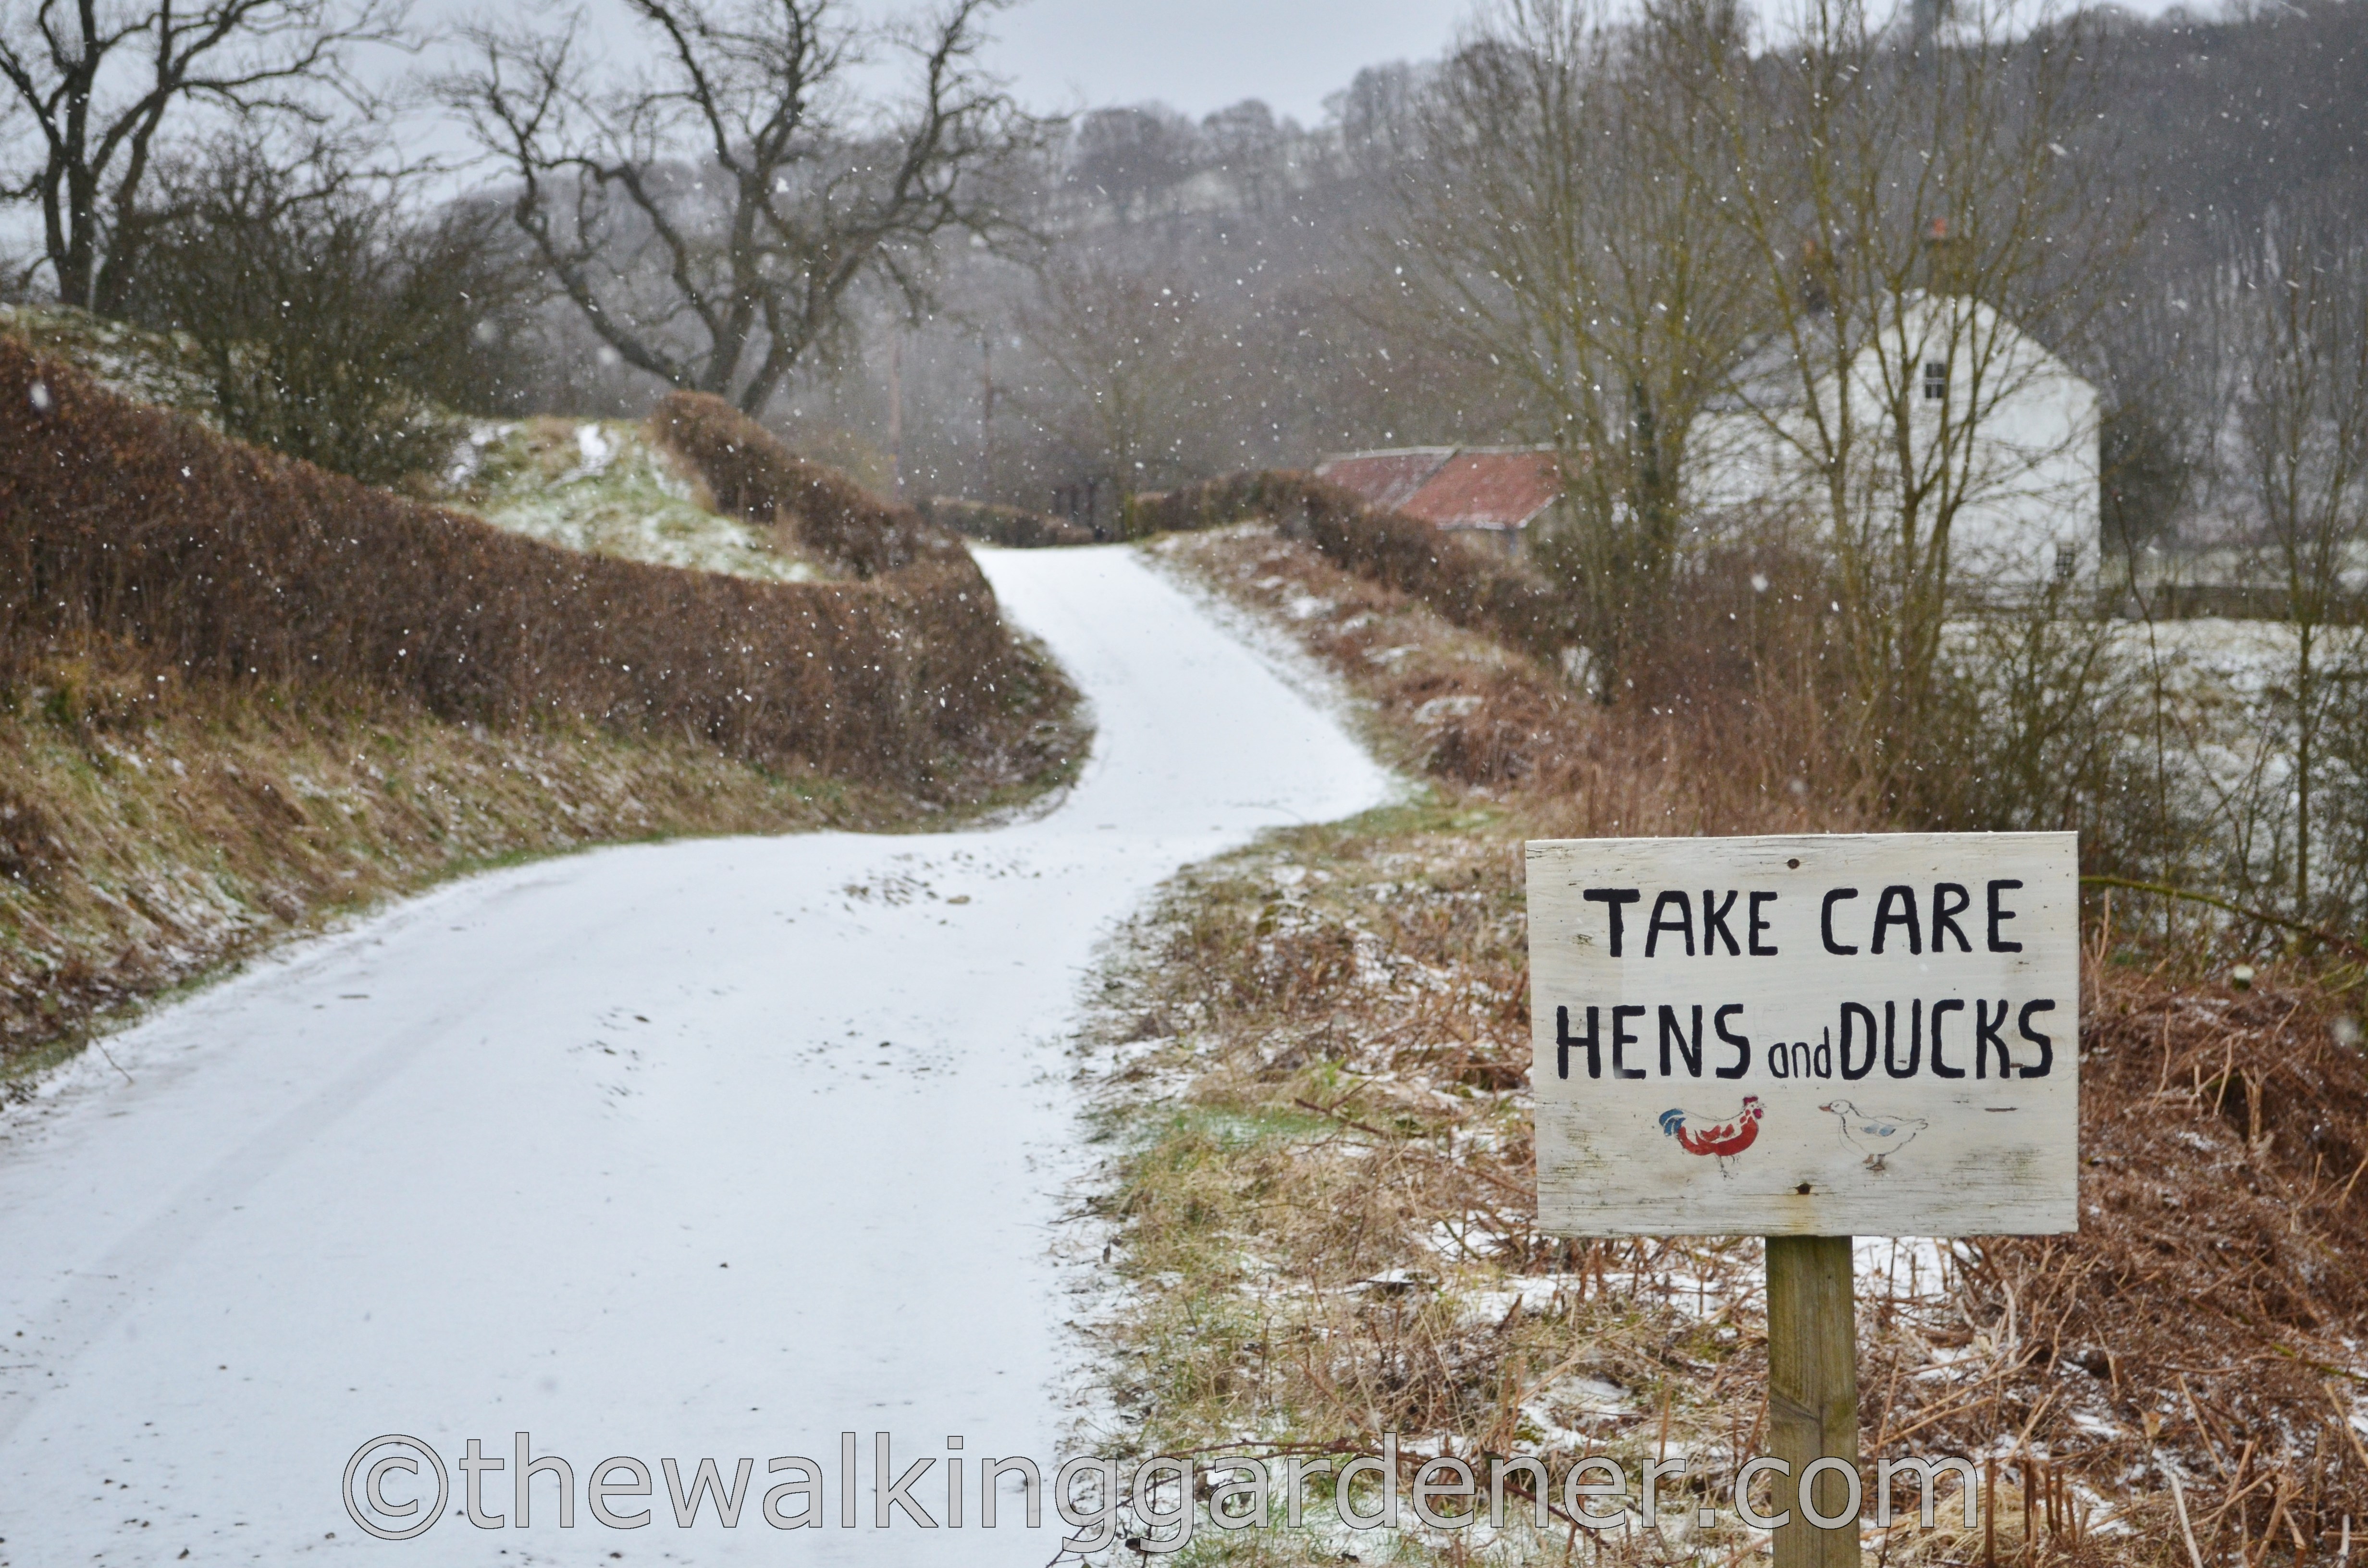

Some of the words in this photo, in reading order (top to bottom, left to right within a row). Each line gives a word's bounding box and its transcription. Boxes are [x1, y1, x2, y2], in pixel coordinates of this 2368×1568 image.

[1583, 888, 1779, 958] TAKE
[1820, 879, 2024, 956] CARE
[1556, 1003, 1751, 1080] HENS
[1767, 1026, 1831, 1079] and
[1840, 998, 2056, 1080] DUCKS
